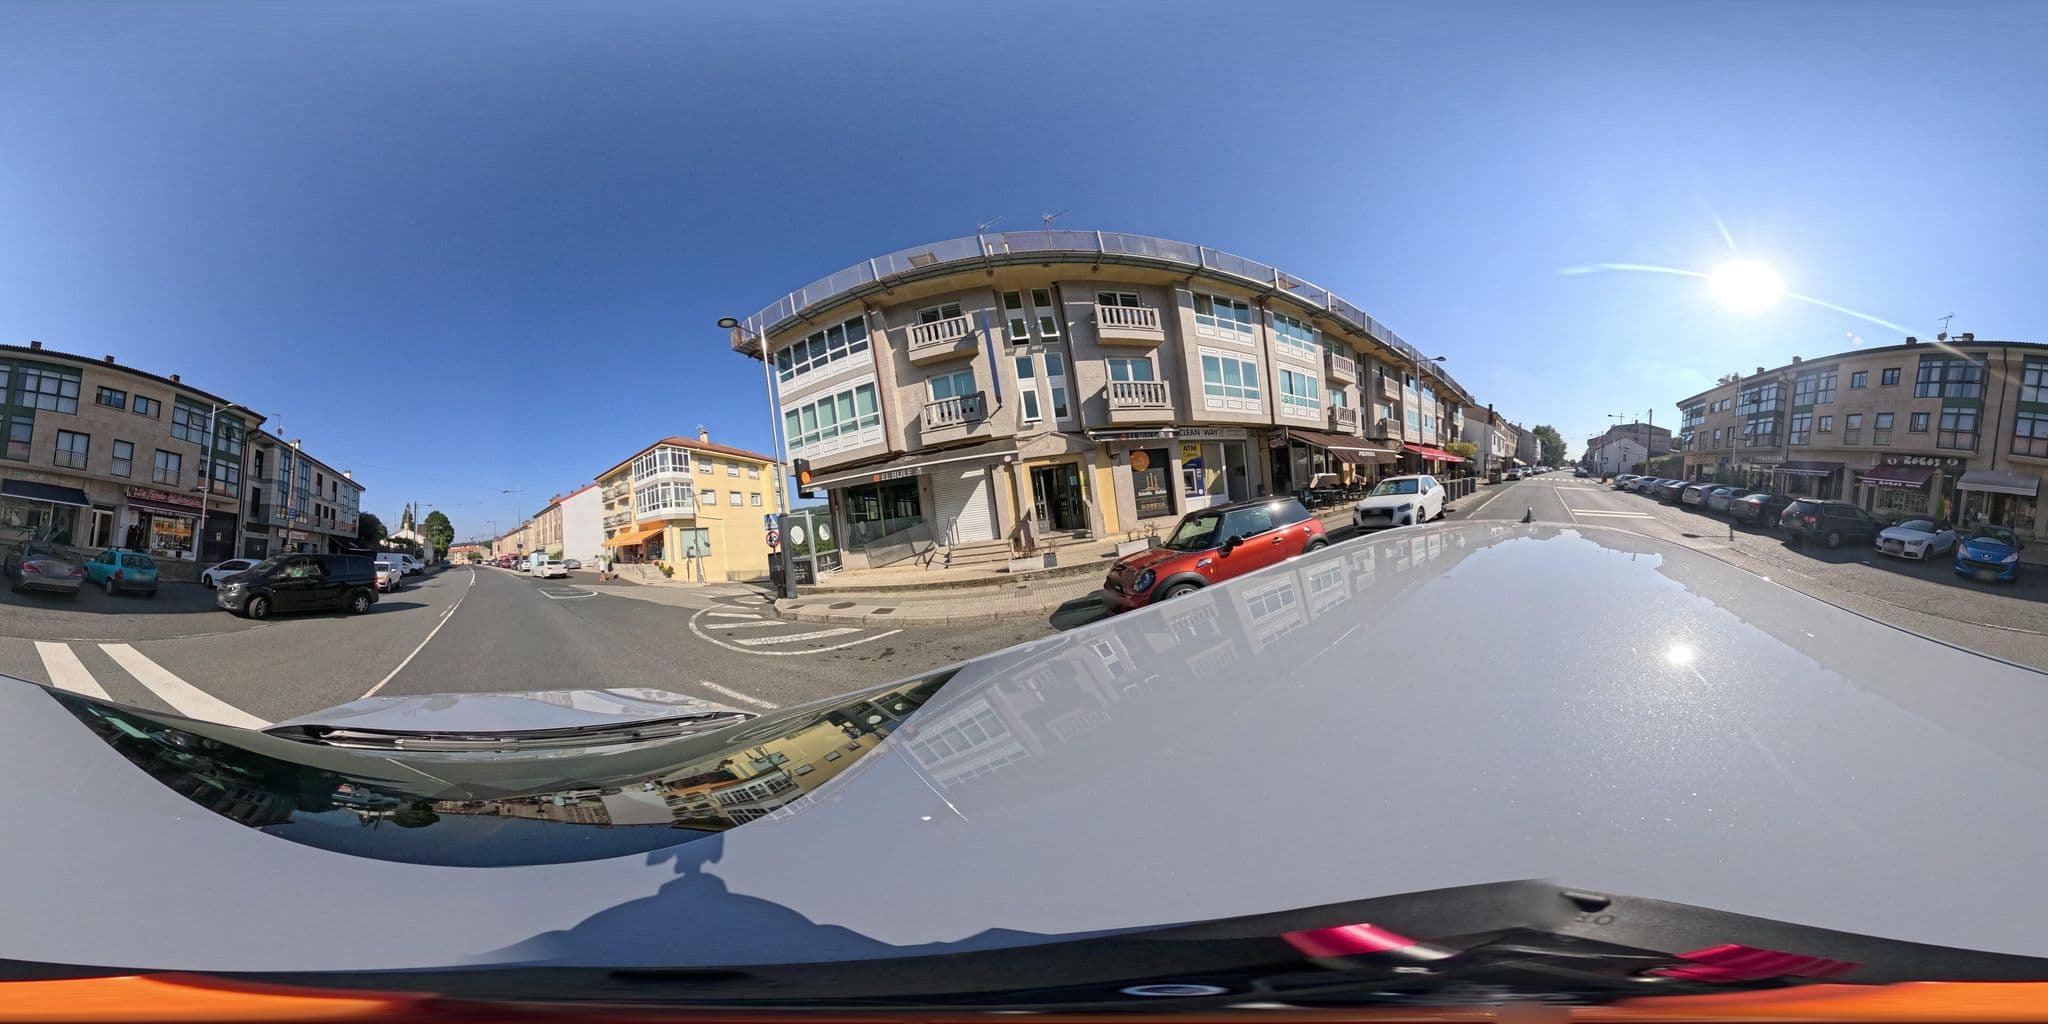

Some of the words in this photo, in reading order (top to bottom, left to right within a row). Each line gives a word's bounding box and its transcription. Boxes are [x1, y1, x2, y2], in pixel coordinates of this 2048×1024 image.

[1180, 428, 1200, 437] CLEAN
[1204, 428, 1218, 436] WAY
[881, 472, 890, 480] EL
[891, 469, 913, 479] BULE
